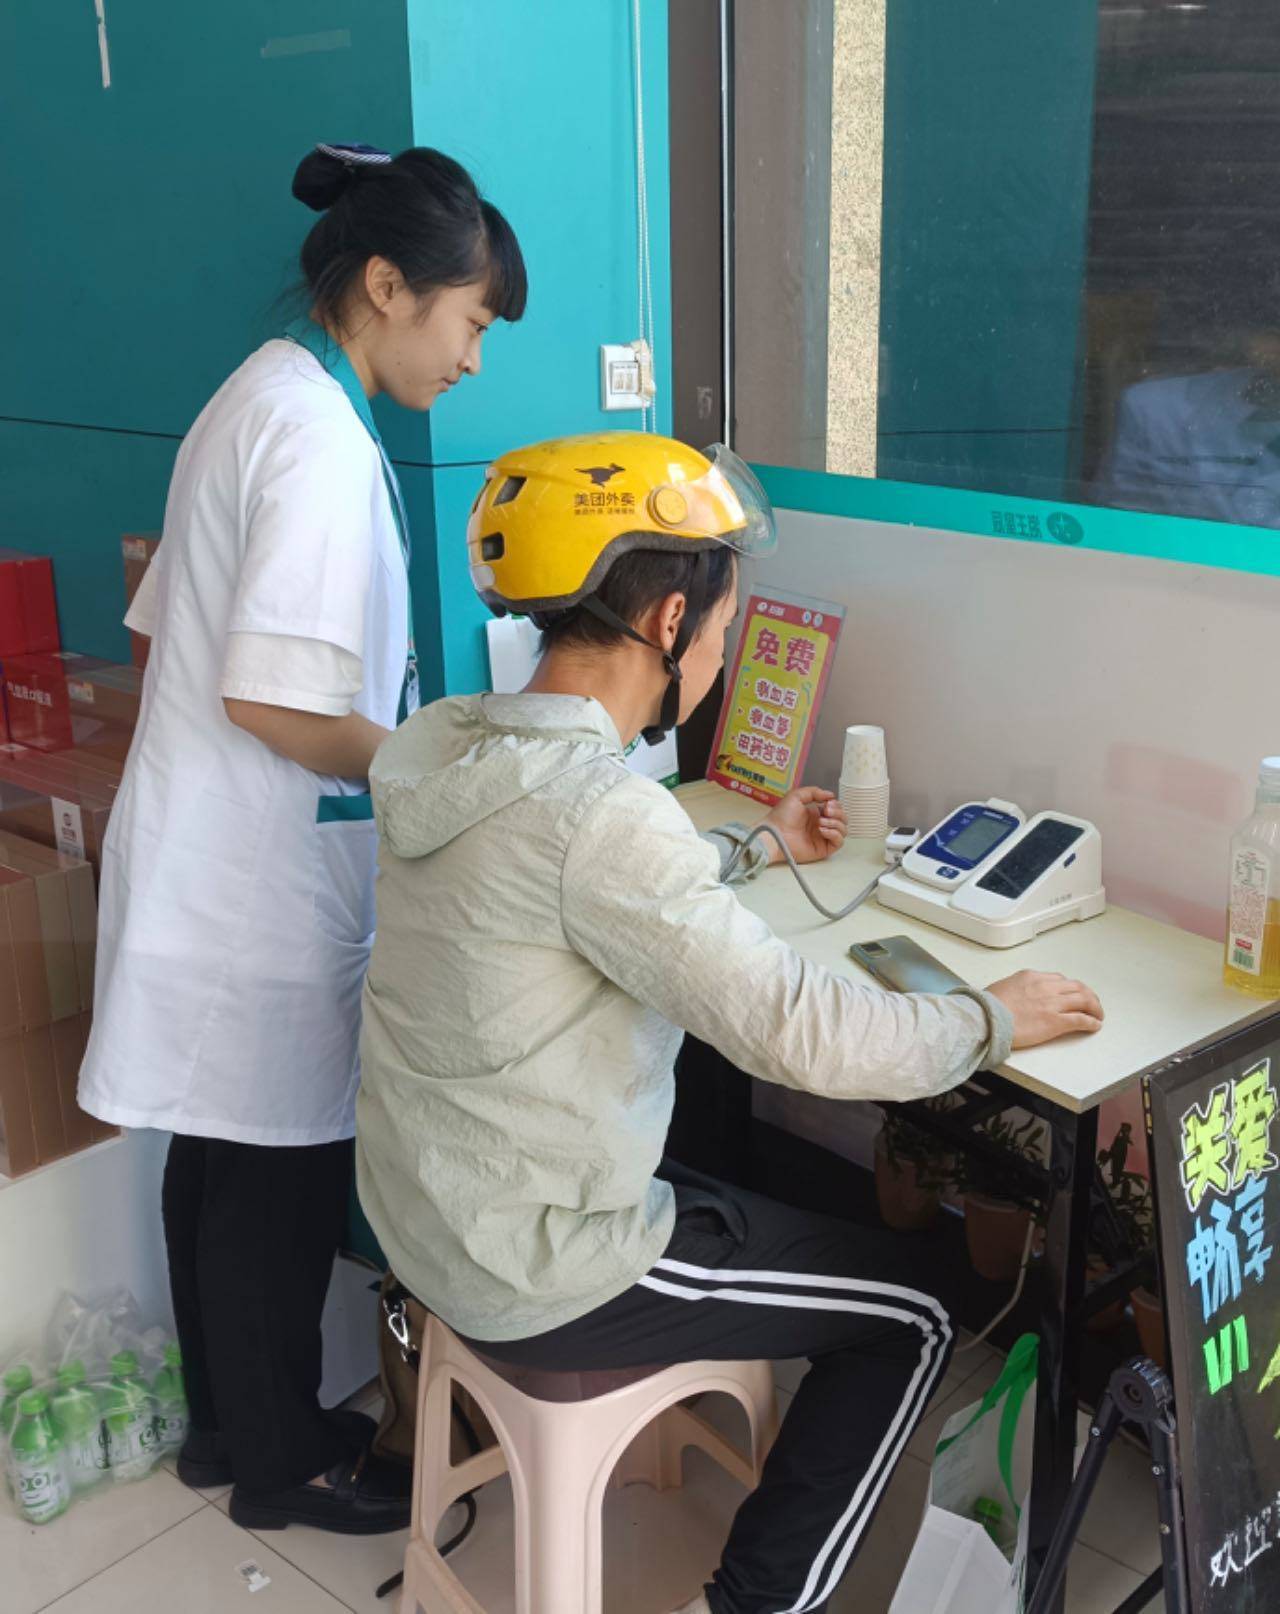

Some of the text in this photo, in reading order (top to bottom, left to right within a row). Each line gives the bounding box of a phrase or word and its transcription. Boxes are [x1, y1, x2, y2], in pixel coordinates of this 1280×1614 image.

[574, 492, 635, 507] 美团外卖
[752, 627, 816, 676] 免费
[1179, 1058, 1279, 1212] 关爱
[1186, 1176, 1273, 1325] 畅享
